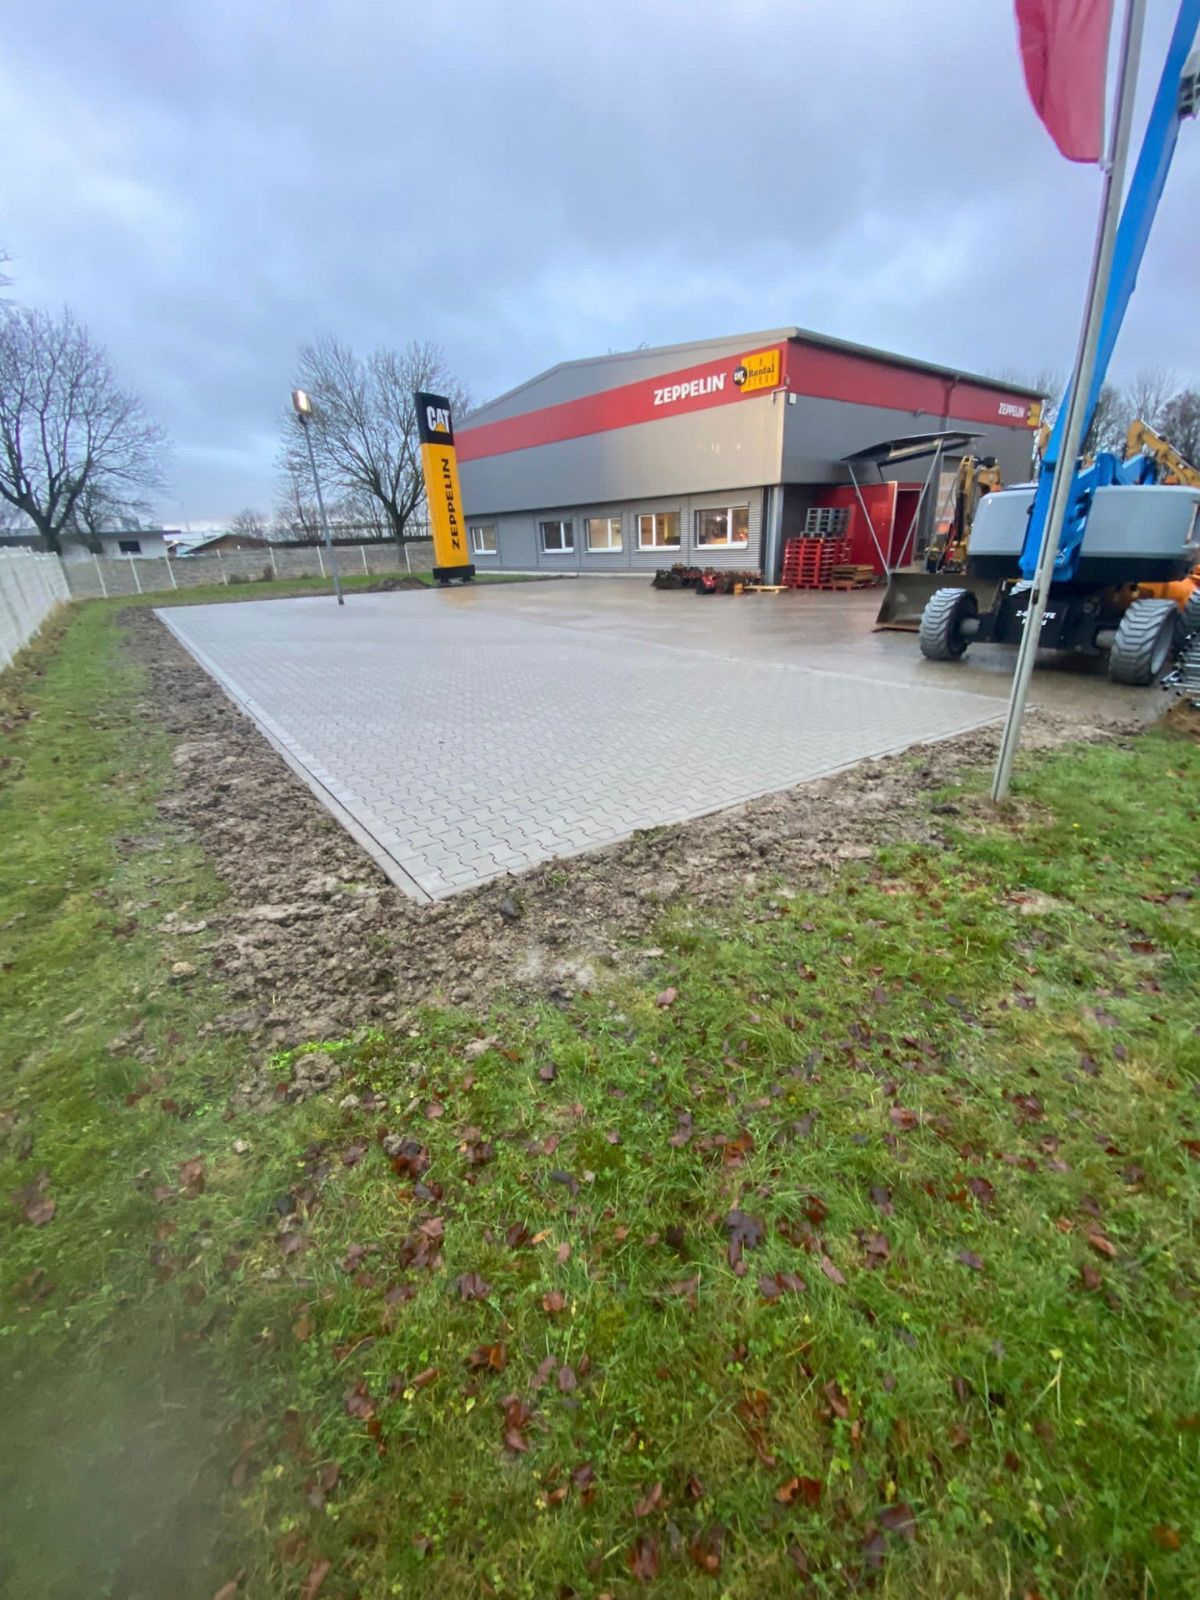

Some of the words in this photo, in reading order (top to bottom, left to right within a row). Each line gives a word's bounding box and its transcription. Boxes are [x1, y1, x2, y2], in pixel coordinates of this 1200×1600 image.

[748, 364, 775, 378] Rental
[653, 373, 727, 406] ZEPPELIN
[426, 405, 450, 434] CAT
[441, 458, 461, 550] ZEPPELIN
